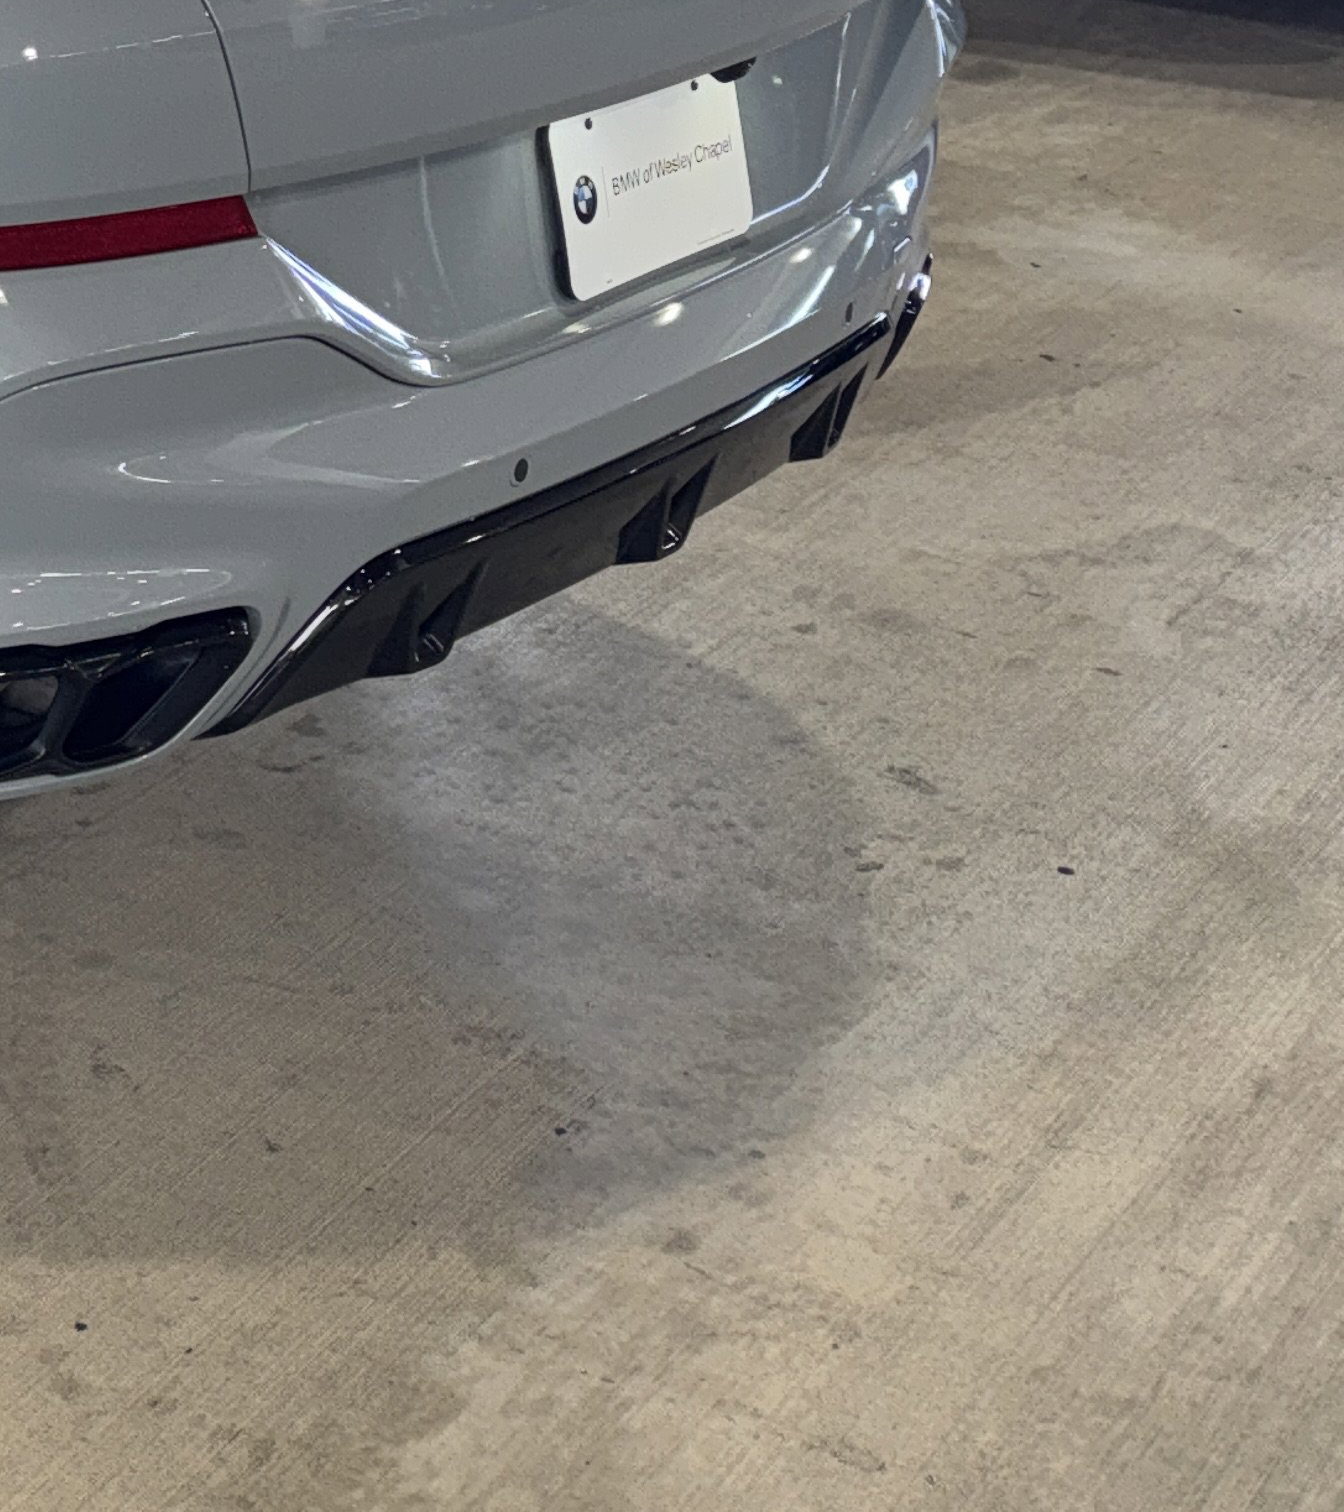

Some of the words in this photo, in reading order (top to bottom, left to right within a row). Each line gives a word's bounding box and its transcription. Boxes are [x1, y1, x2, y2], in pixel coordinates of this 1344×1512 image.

[611, 168, 641, 196] BMW
[643, 162, 655, 184] of
[654, 151, 694, 179] Wesley
[694, 134, 733, 163] Chapel
